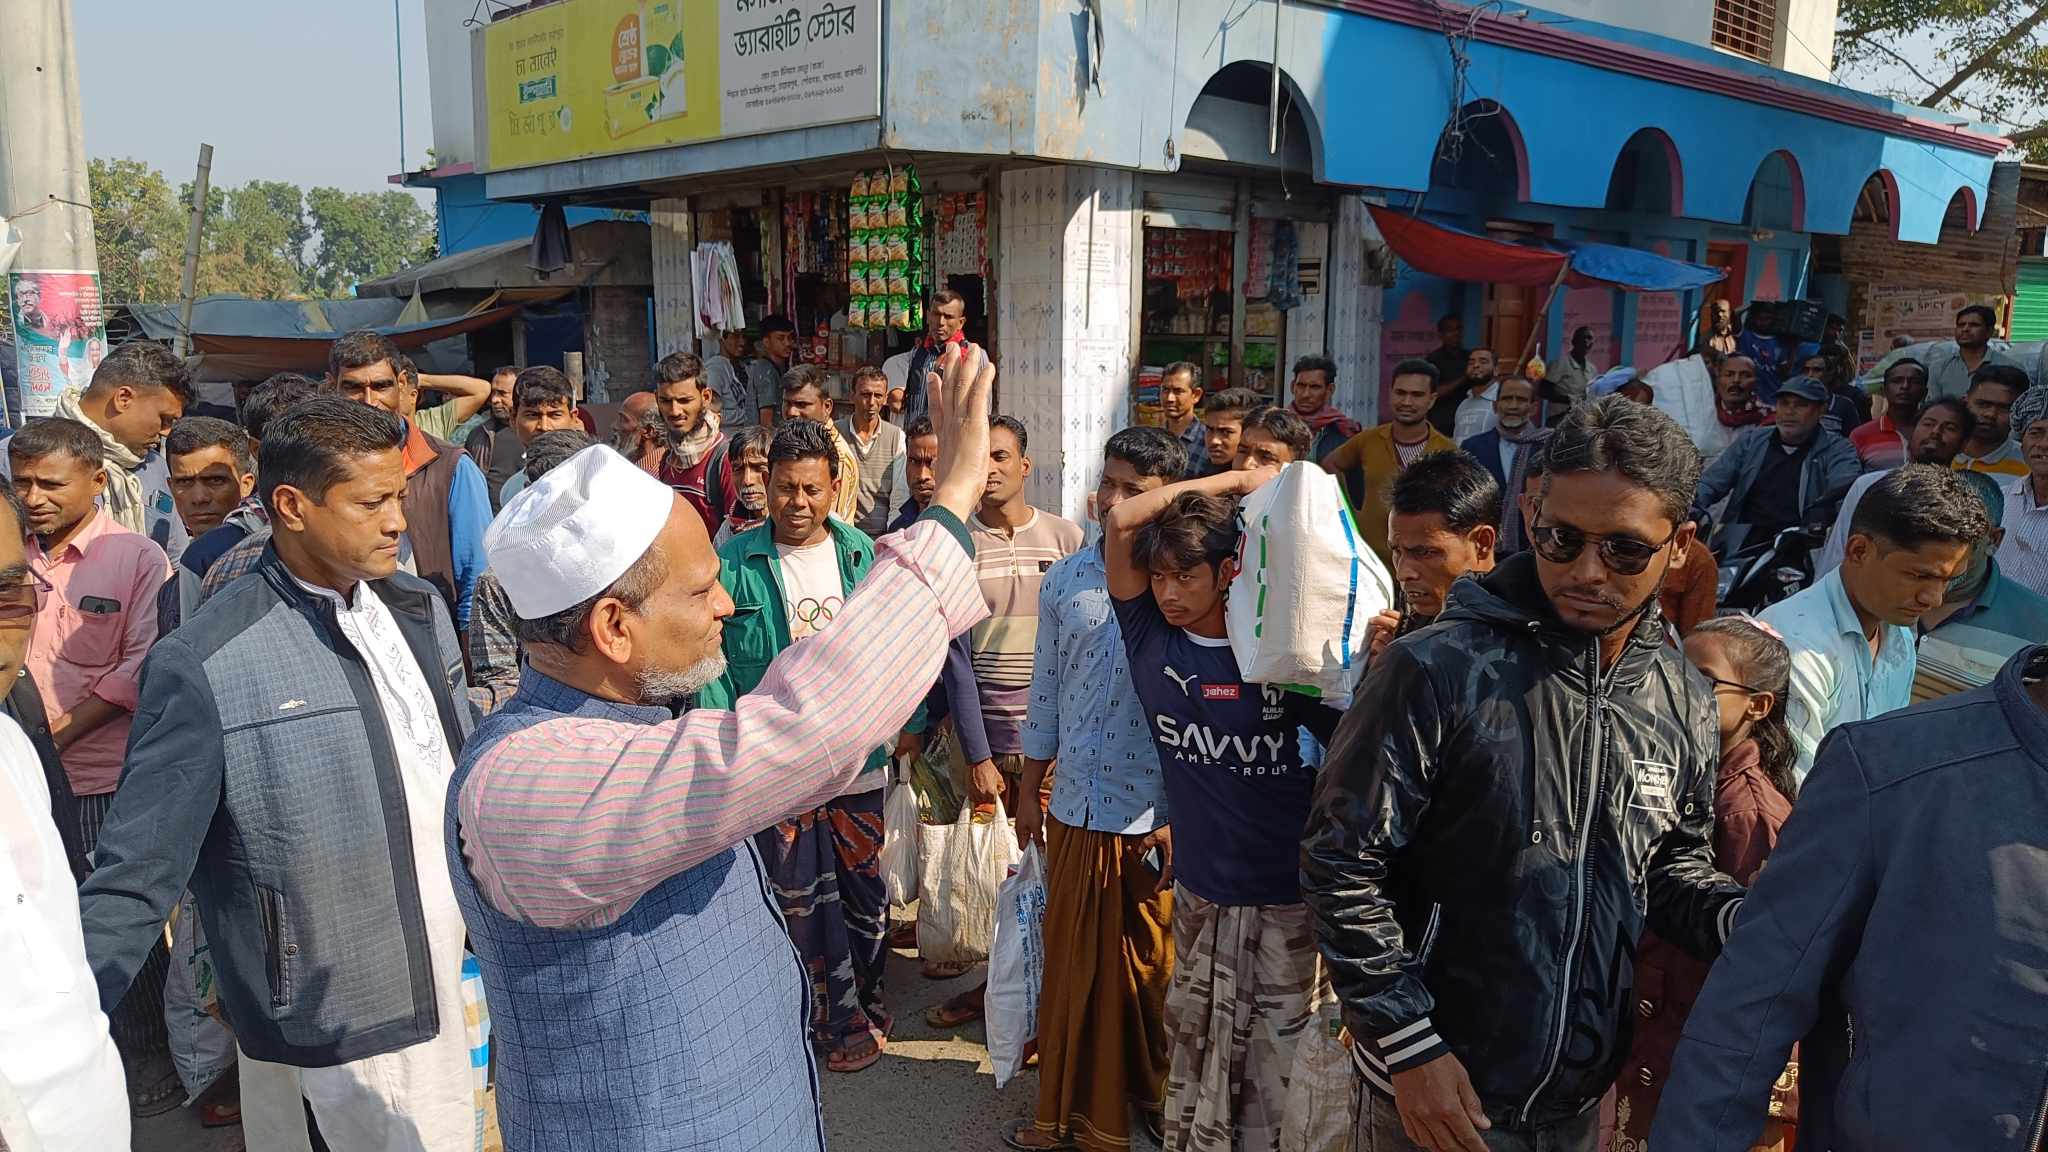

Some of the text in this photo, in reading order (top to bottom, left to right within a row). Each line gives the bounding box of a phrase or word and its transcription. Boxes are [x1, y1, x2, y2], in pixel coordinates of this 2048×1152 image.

[733, 2, 856, 56] ভ্যারাইটি স্টোর
[1203, 686, 1237, 697] jahez
[1156, 714, 1284, 763] SAVVY
[1166, 747, 1222, 765] AME
